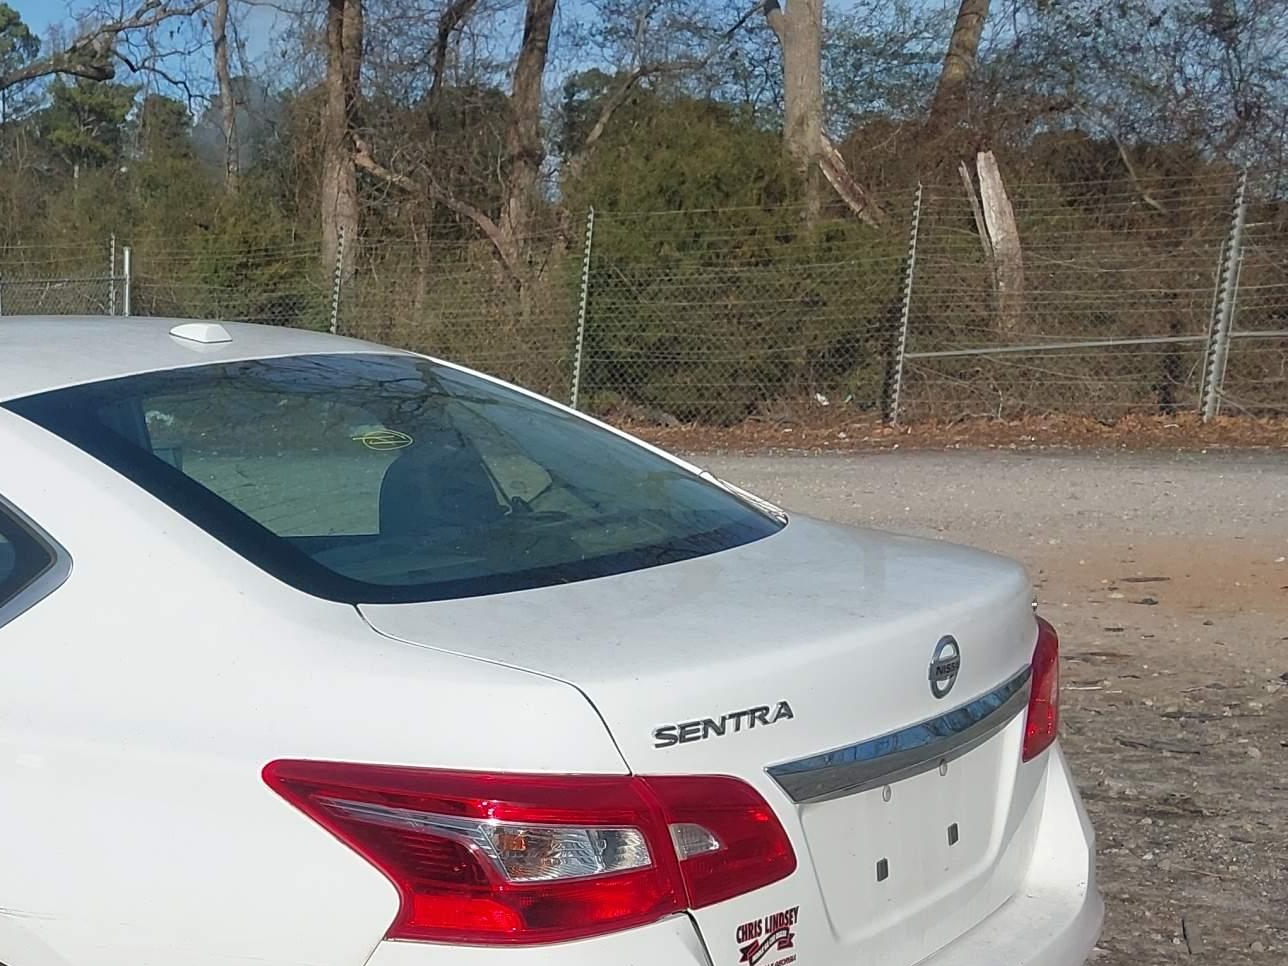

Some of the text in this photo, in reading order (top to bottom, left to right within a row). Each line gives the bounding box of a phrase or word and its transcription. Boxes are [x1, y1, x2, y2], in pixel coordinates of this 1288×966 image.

[655, 701, 794, 748] SENTRA
[736, 906, 800, 944] CHRIS LINDSEY
